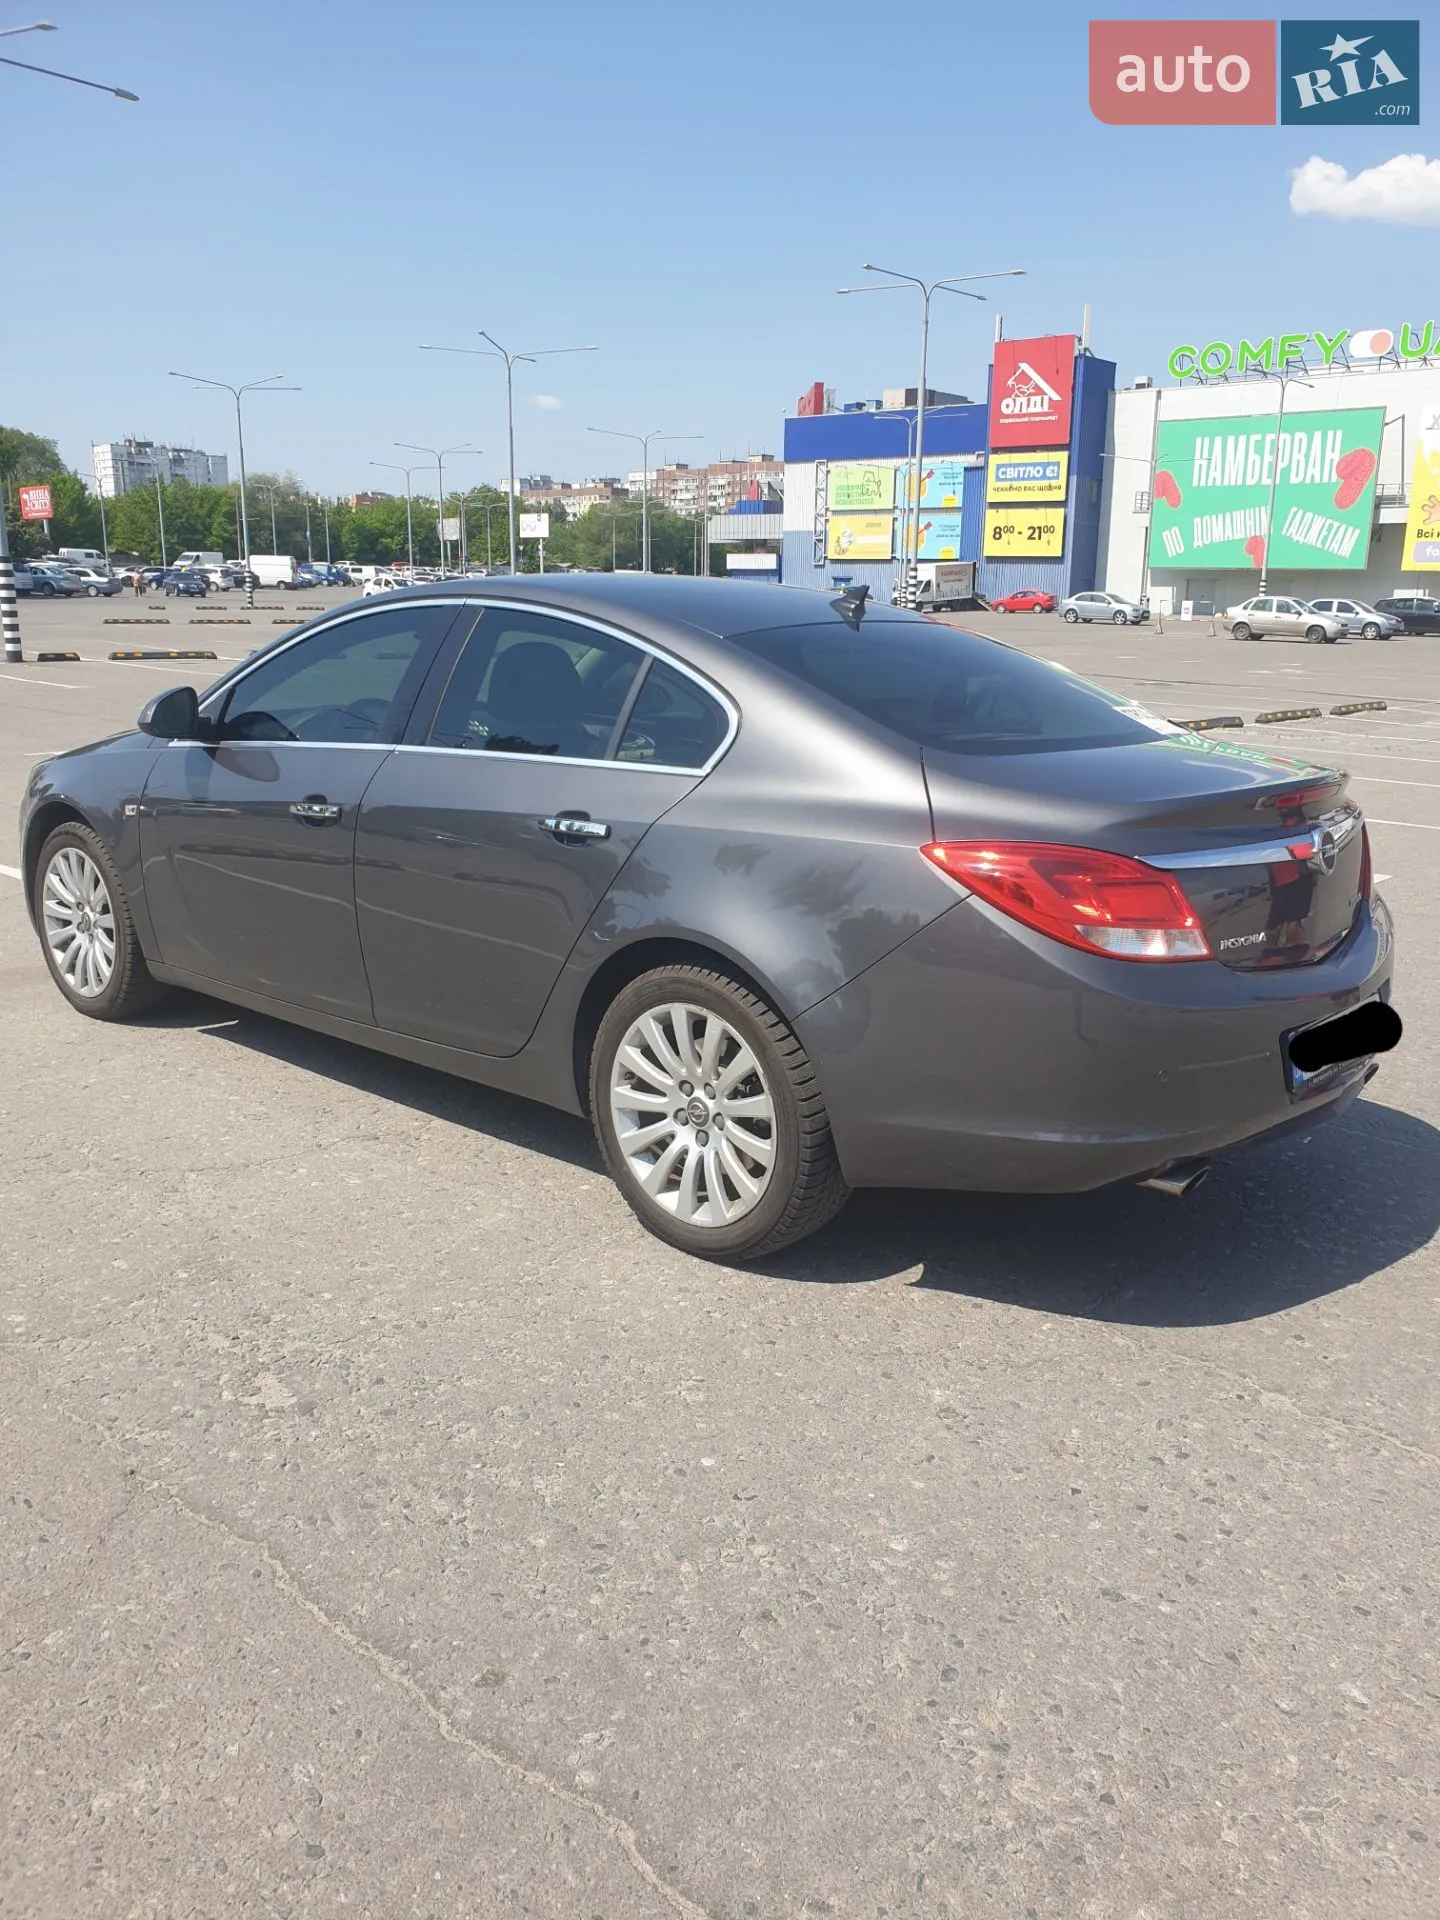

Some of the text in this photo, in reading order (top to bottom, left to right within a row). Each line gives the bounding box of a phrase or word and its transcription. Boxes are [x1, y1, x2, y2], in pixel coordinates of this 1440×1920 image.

[1168, 329, 1350, 379] COMFY
[1001, 395, 1051, 414] ОЛДІ
[1192, 430, 1343, 487] НАМБЕРВАН
[998, 465, 1058, 479] СВІТЛО Є!
[1037, 484, 1062, 492] ЩОДНЯ
[1162, 526, 1184, 558] ПО
[1281, 506, 1361, 558] ГАДЖЕТАМ
[1416, 528, 1434, 538] Всі
[1425, 545, 1440, 558] fo
[1220, 932, 1267, 950] INSIGNIA
